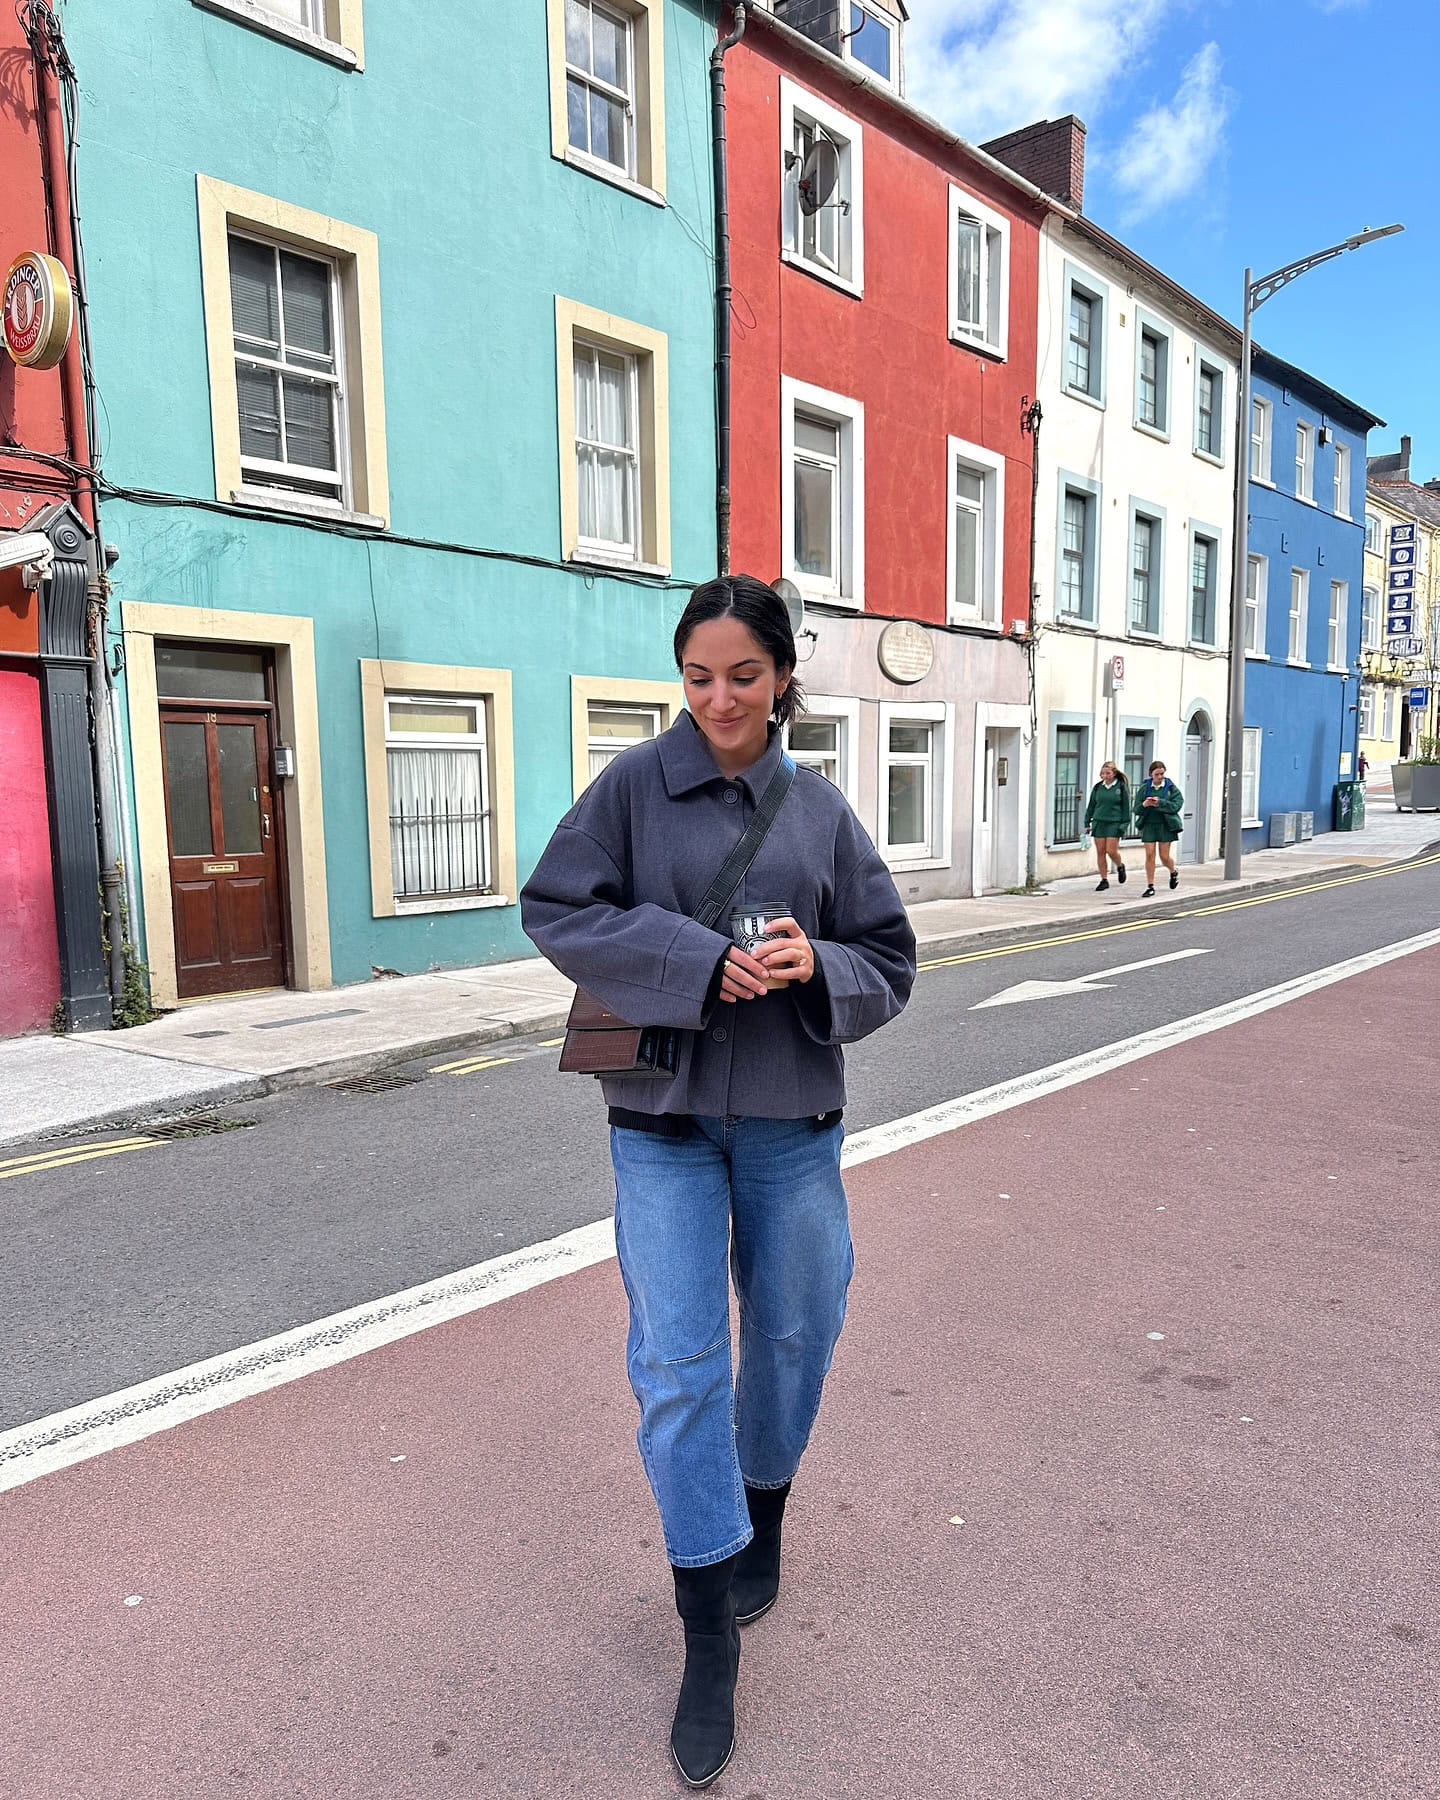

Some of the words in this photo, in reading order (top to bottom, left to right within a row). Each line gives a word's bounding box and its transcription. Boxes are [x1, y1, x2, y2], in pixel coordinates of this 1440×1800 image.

[1390, 525, 1412, 632] HOTEL
[1388, 639, 1422, 655] ASHLEY
[206, 712, 217, 723] 18
